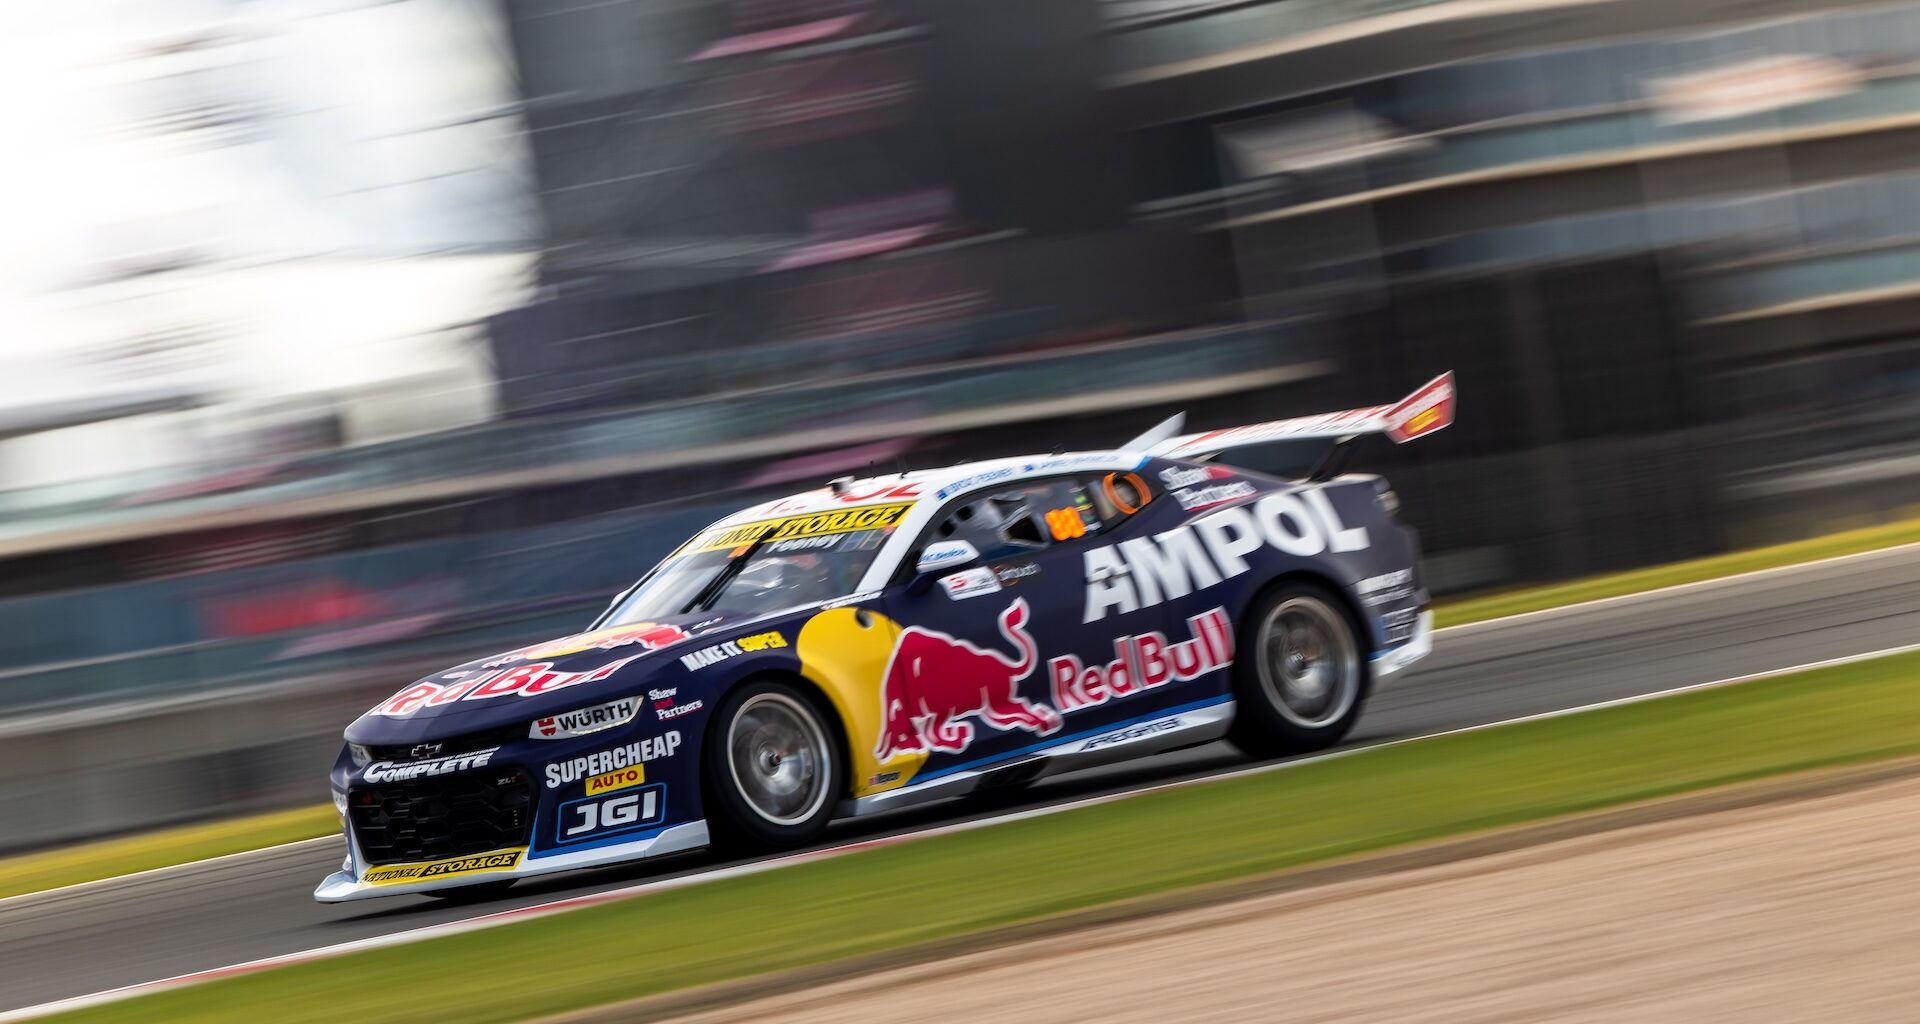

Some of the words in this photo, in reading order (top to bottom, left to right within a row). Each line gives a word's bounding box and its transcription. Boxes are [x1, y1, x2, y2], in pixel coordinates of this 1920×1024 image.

[776, 505, 901, 537] STORAGE
[766, 533, 847, 554] Feeney
[1083, 487, 1371, 624] AMPOL
[680, 644, 728, 672] MAKE
[721, 640, 743, 657] IT
[1048, 633, 1140, 714] Red
[1132, 607, 1236, 691] Bull
[648, 687, 677, 701] Shaw
[558, 701, 633, 731] WÜRTH
[656, 700, 704, 721] Partners
[363, 752, 494, 783] COMPLETE
[545, 730, 681, 789] SUPERCHEAP
[591, 770, 639, 791] AUTO
[566, 791, 657, 836] JGI
[361, 864, 421, 884] NATIONAL
[427, 852, 515, 875] STORAGE
